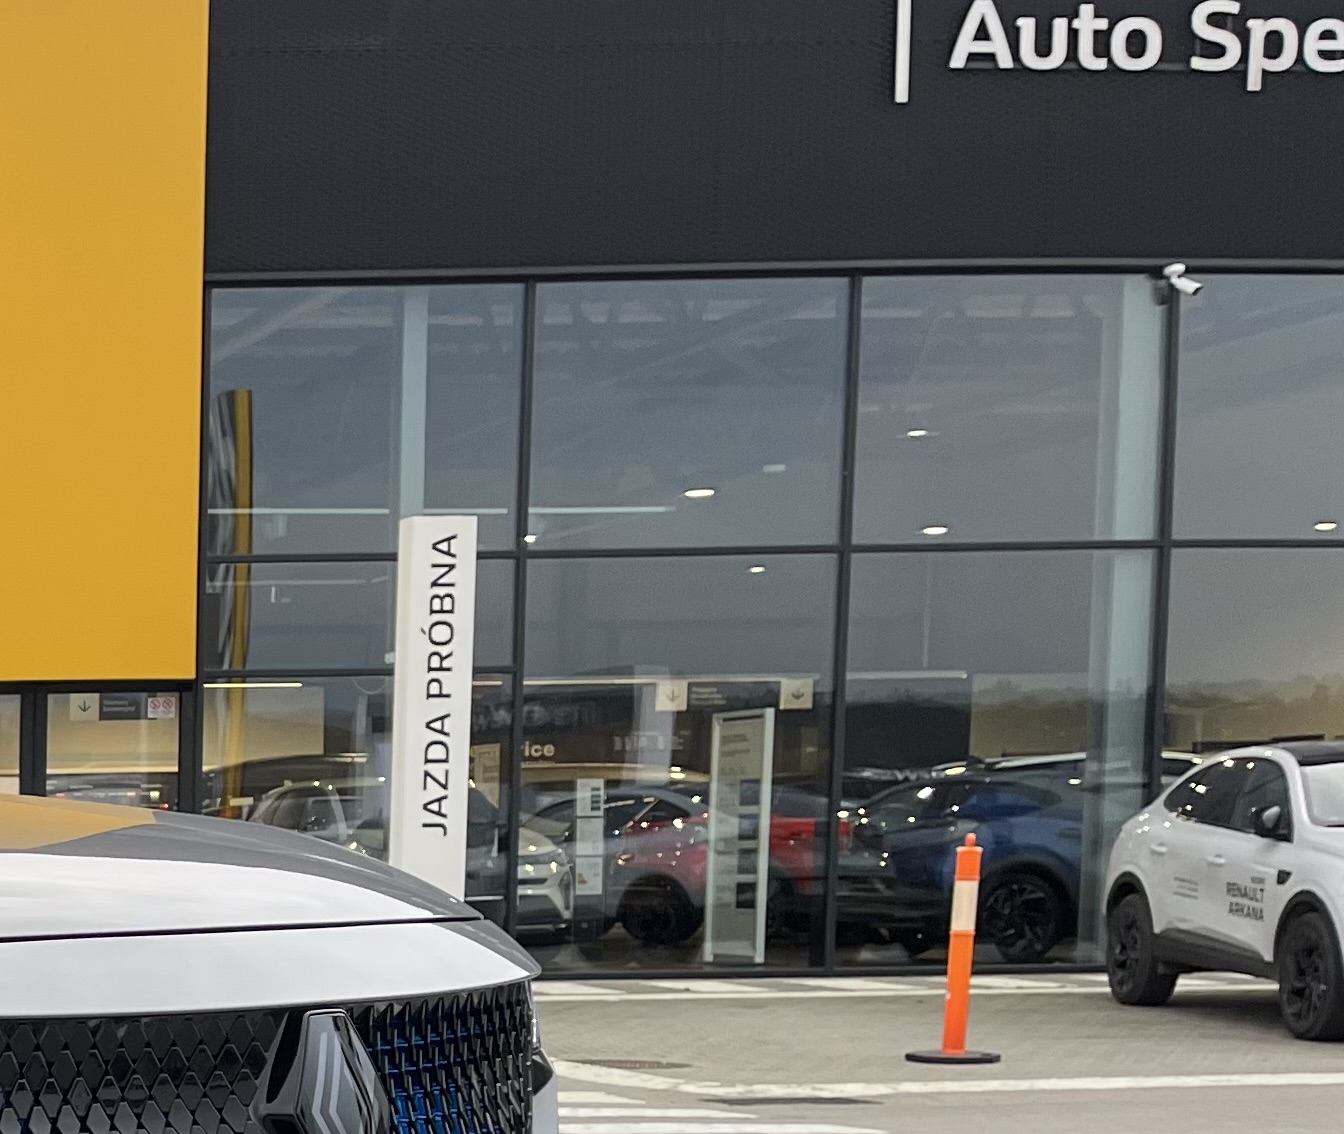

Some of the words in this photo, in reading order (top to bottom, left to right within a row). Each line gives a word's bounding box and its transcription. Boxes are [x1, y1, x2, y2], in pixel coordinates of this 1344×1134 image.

[948, 0, 1163, 71] Auto
[1190, 0, 1344, 92] Spe
[420, 534, 458, 700] PRÓBNA
[422, 713, 451, 837] JAZDA
